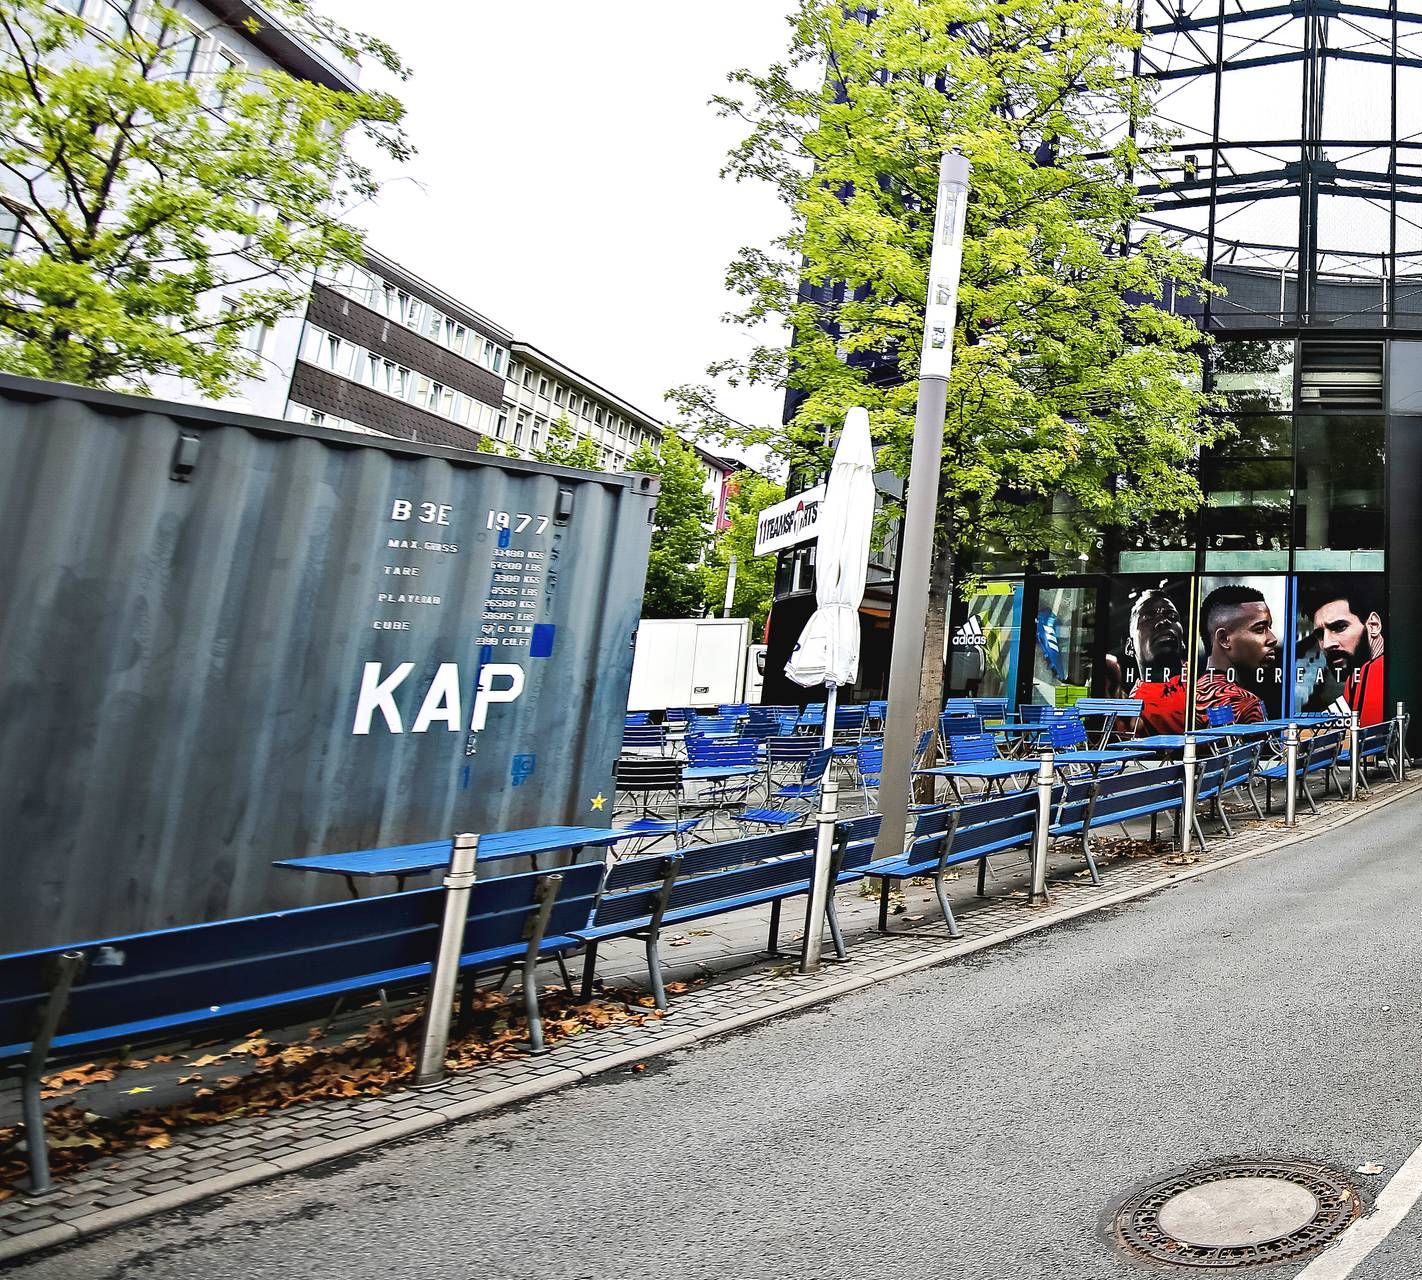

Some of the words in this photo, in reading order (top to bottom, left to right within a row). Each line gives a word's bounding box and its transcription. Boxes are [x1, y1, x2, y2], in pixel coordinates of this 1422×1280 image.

[486, 510, 550, 535] 1977
[527, 550, 545, 560] KGS
[384, 566, 421, 577] TARE
[525, 562, 543, 572] LBS
[523, 575, 541, 584] KGS
[521, 588, 538, 597] LBS
[519, 600, 537, 609] KGS
[517, 612, 535, 621] LBS
[373, 620, 411, 631] CUBE
[952, 634, 987, 645] adidas
[1127, 667, 1188, 683] HERE
[1207, 667, 1236, 683] TO
[1256, 667, 1361, 683] CREATE
[352, 661, 526, 735] KAP
